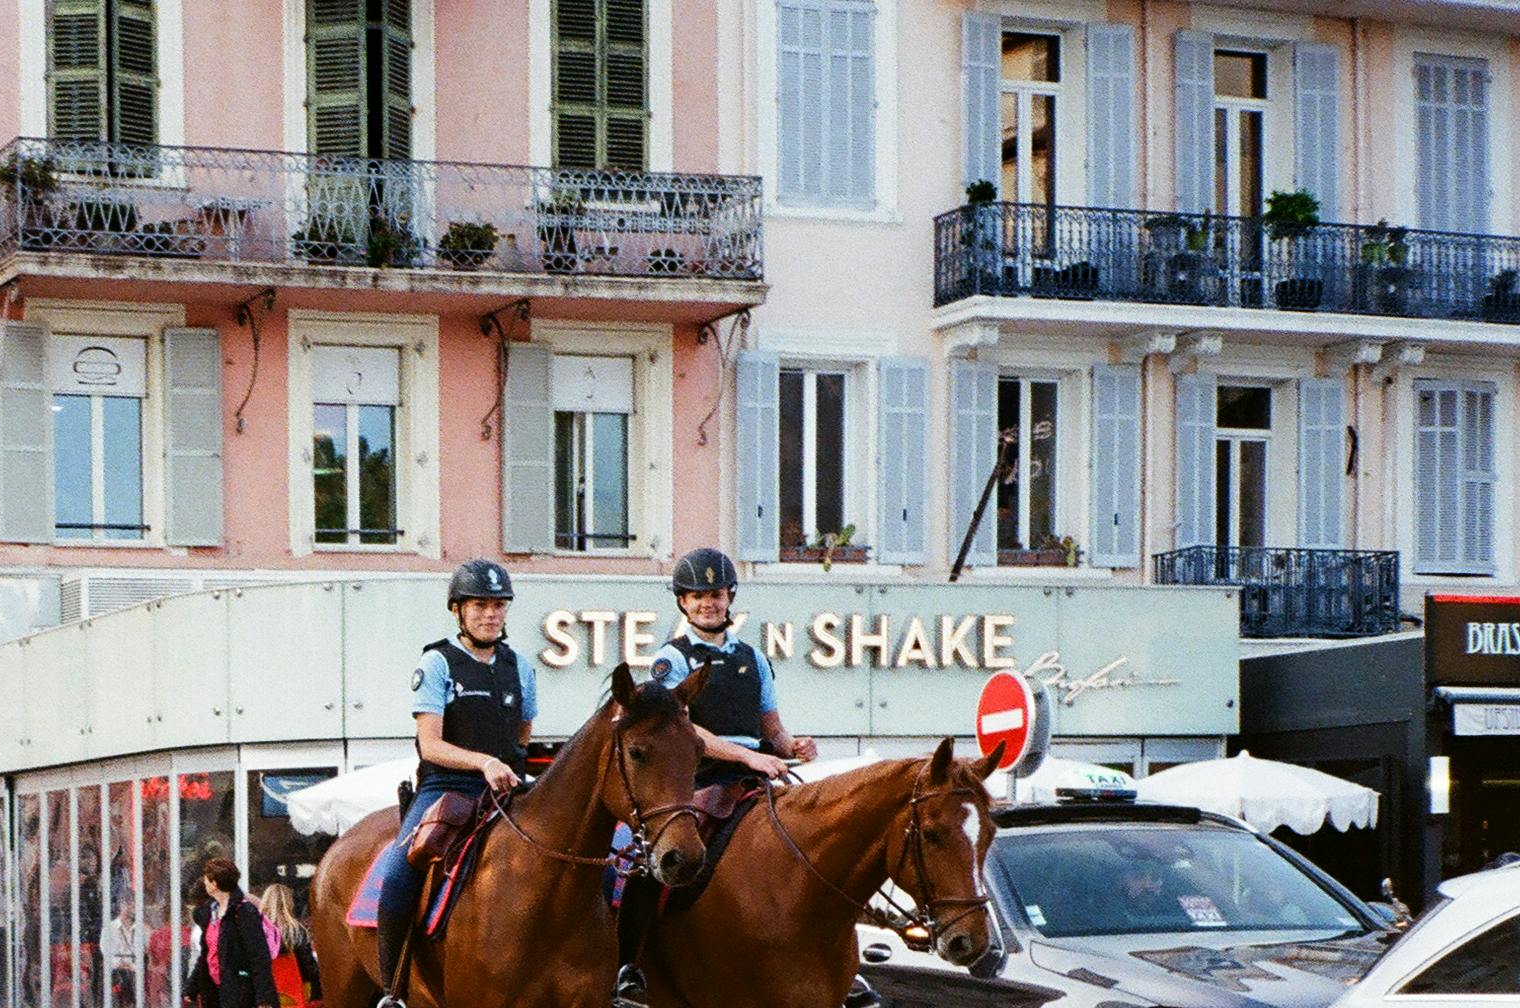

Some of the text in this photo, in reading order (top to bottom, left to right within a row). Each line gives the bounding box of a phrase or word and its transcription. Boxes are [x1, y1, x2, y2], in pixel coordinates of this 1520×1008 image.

[539, 608, 1017, 669] STE N SHAKE
[1085, 773, 1126, 785] TAXI
